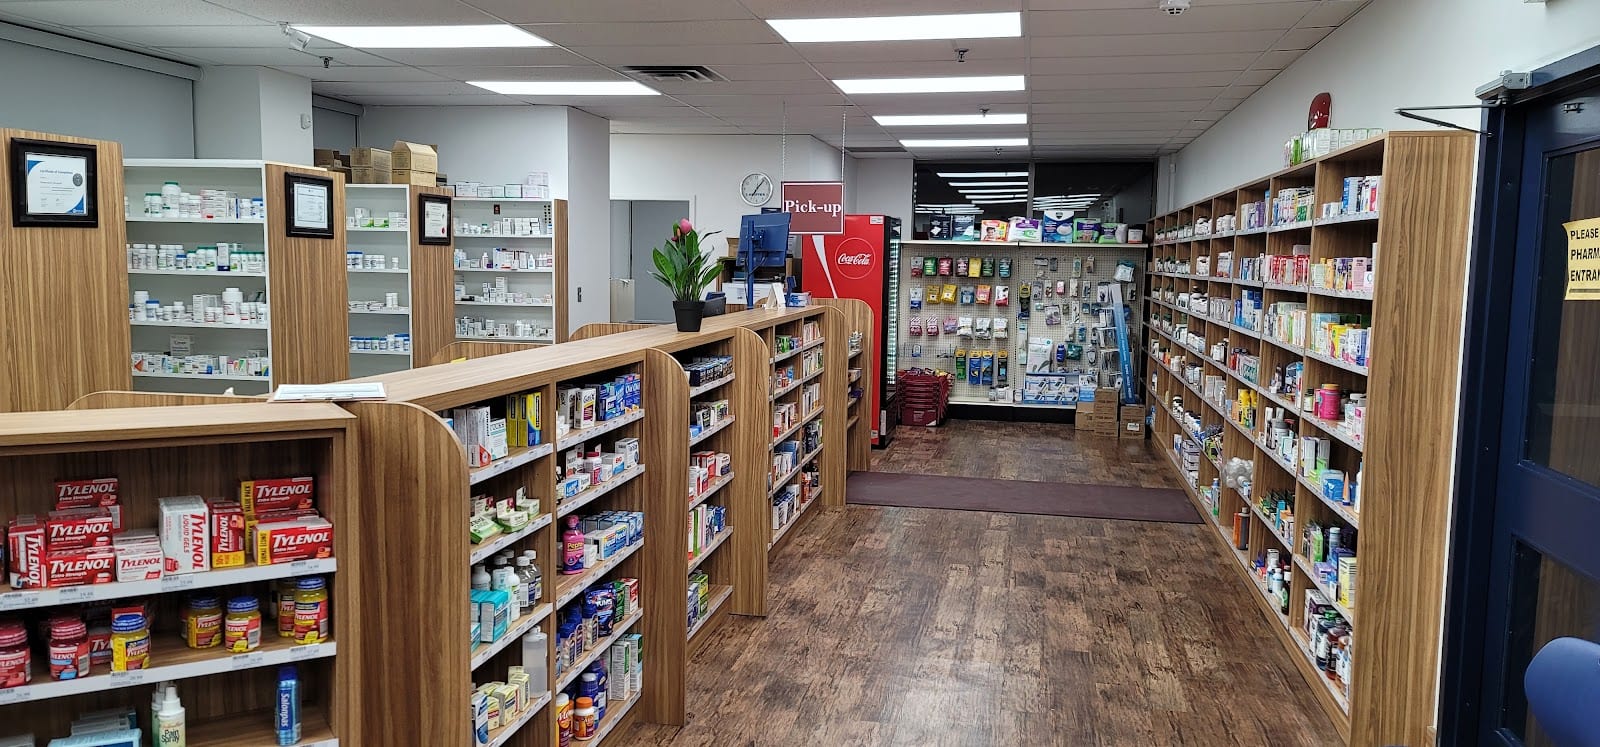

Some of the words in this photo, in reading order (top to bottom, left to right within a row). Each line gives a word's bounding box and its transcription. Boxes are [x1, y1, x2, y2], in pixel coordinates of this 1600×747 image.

[784, 199, 842, 217] Pick-up
[1570, 227, 1599, 240] PLEASE
[1570, 247, 1600, 260] PHARM
[58, 483, 116, 497] TYLENOL
[256, 484, 311, 498] TYLENOL
[50, 523, 110, 537] TYLENOL
[218, 515, 229, 552] TYLENOL
[190, 512, 207, 570] TYLENOL
[272, 532, 329, 548] TYLENOL
[26, 535, 42, 586] TYLENOL
[50, 559, 111, 574] TYLENOL
[121, 557, 161, 568] TYLENOL
[280, 693, 290, 727] Salonpas
[164, 729, 180, 738] Pain
